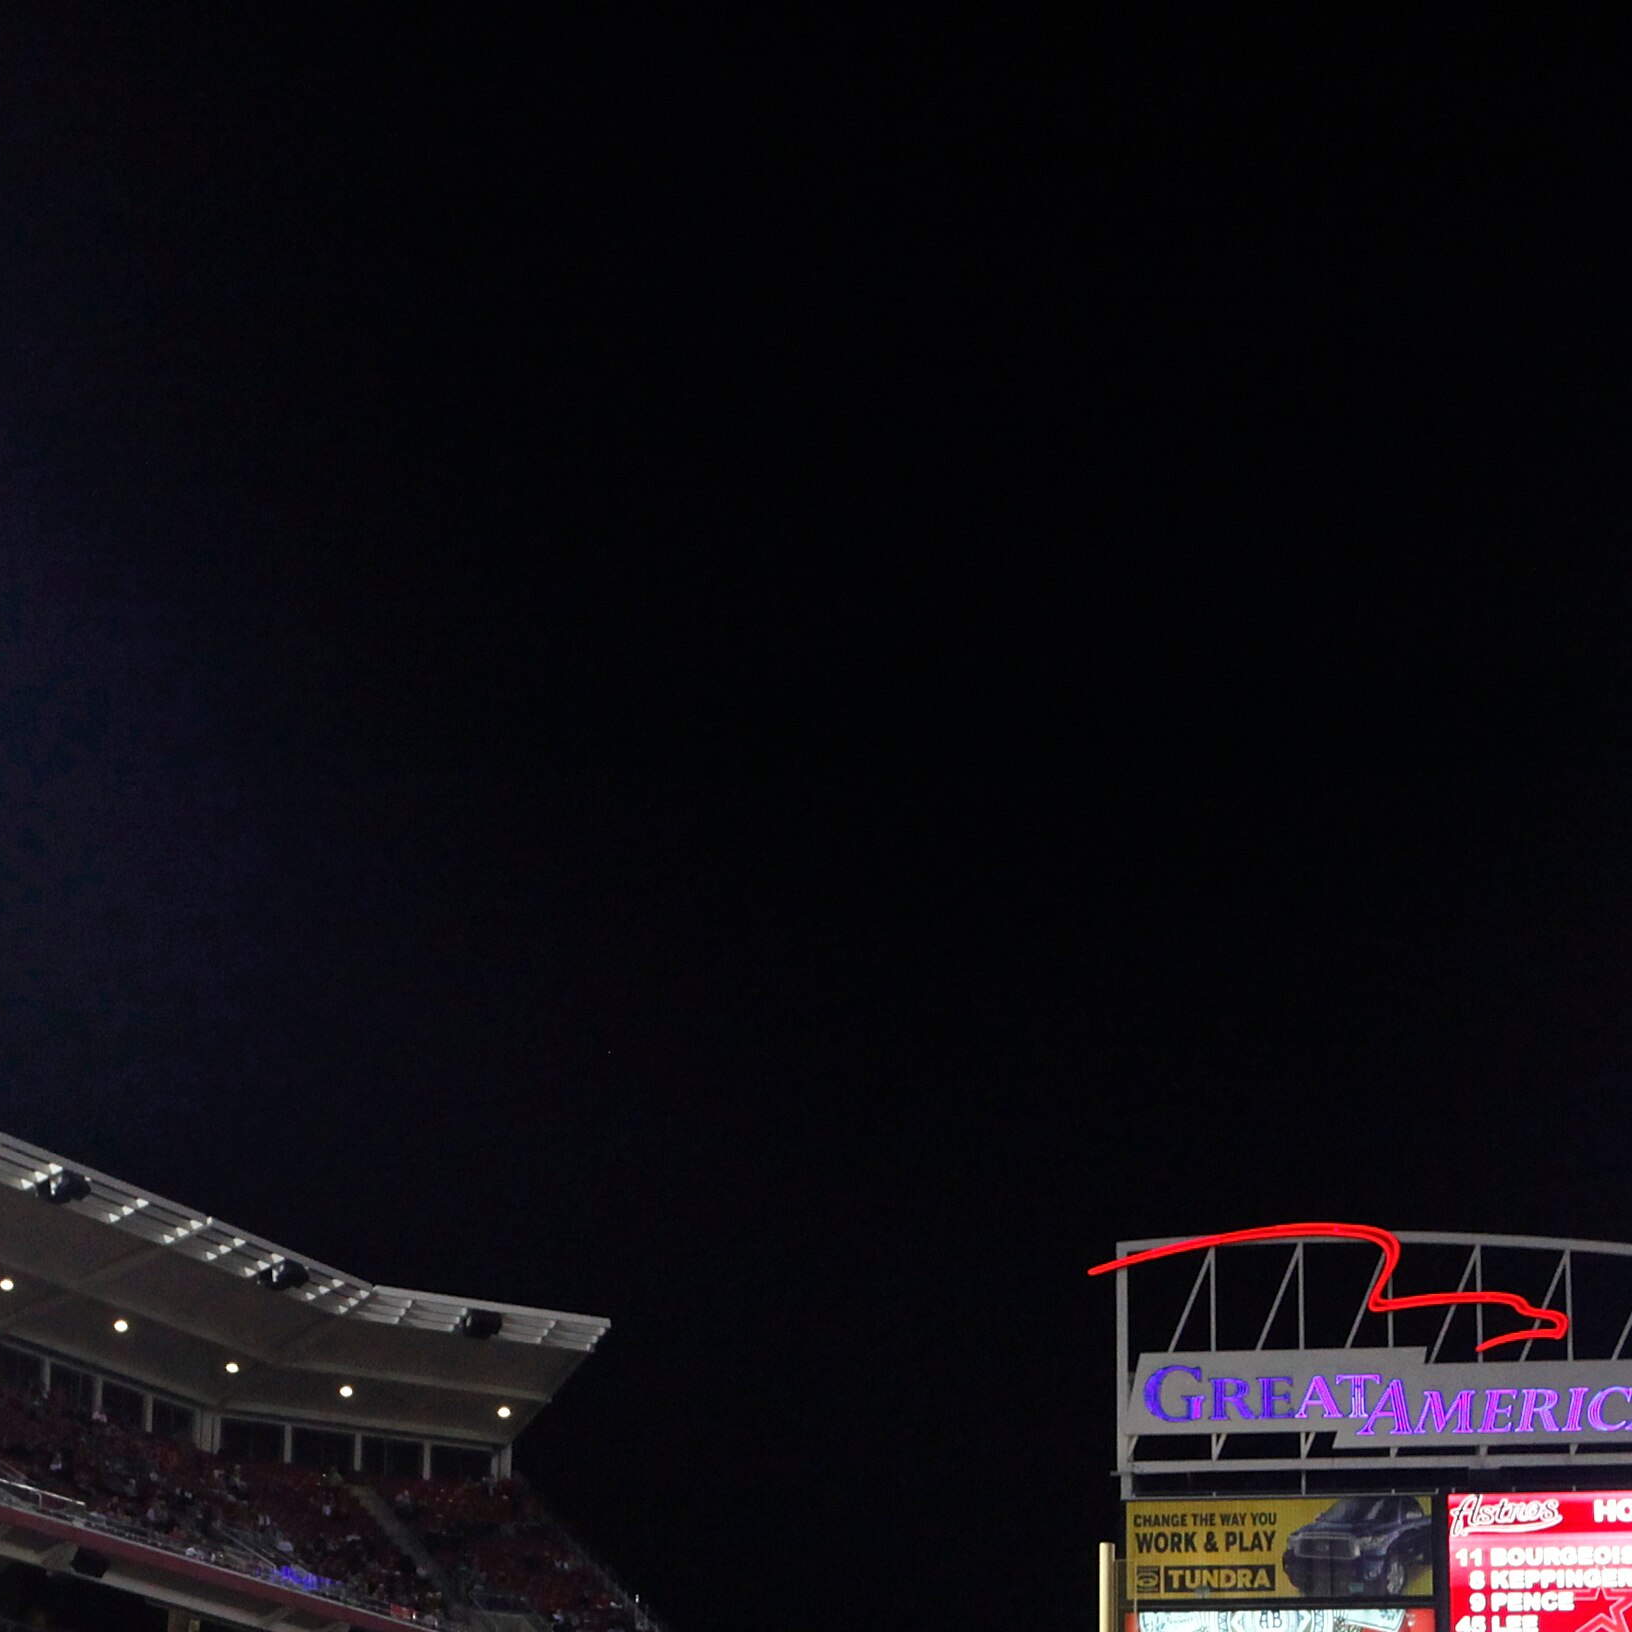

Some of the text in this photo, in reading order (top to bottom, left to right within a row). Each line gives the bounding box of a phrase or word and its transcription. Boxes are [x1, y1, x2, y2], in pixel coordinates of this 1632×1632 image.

[1143, 1364, 1383, 1423] GREAT
[1133, 1512, 1277, 1527] CHANGE THE WAY YOU
[1450, 1494, 1563, 1536] Astros
[1134, 1530, 1277, 1554] WORK & PLAY
[1166, 1567, 1275, 1589] TUNDRA
[1491, 1591, 1574, 1611] PENCE
